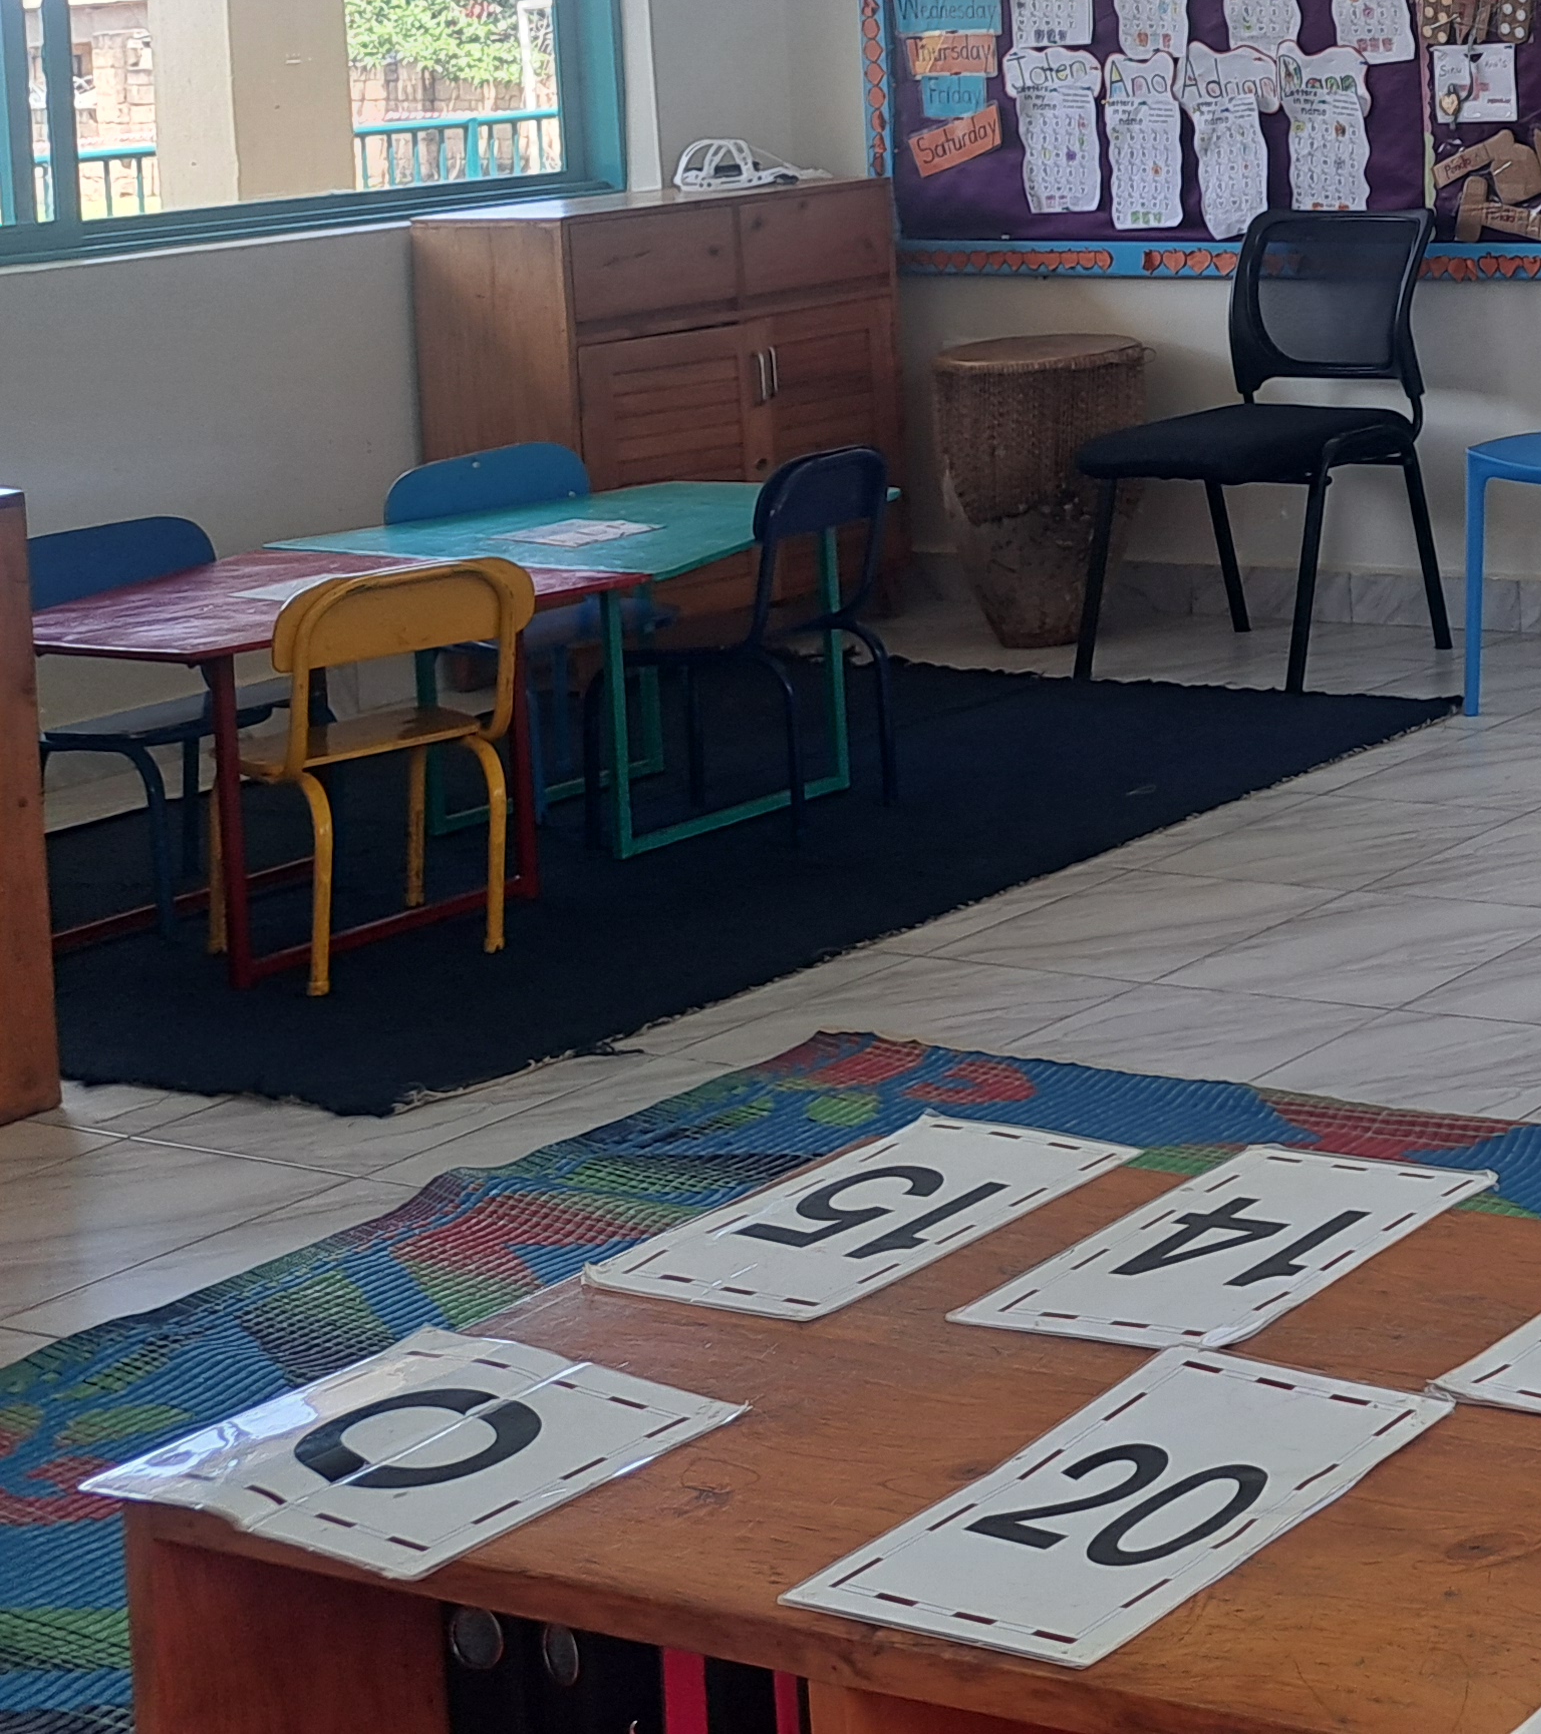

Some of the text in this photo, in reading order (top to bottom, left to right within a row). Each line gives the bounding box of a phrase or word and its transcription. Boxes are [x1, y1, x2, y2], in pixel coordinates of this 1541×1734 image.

[906, 35, 992, 77] Thursday
[928, 77, 982, 114] Friday
[1110, 60, 1168, 98] Ana
[1181, 58, 1277, 99] Adrian
[916, 117, 997, 164] Saturday
[733, 1163, 1012, 1261] 15
[1107, 1193, 1373, 1288] 14
[963, 1441, 1271, 1568] 20
